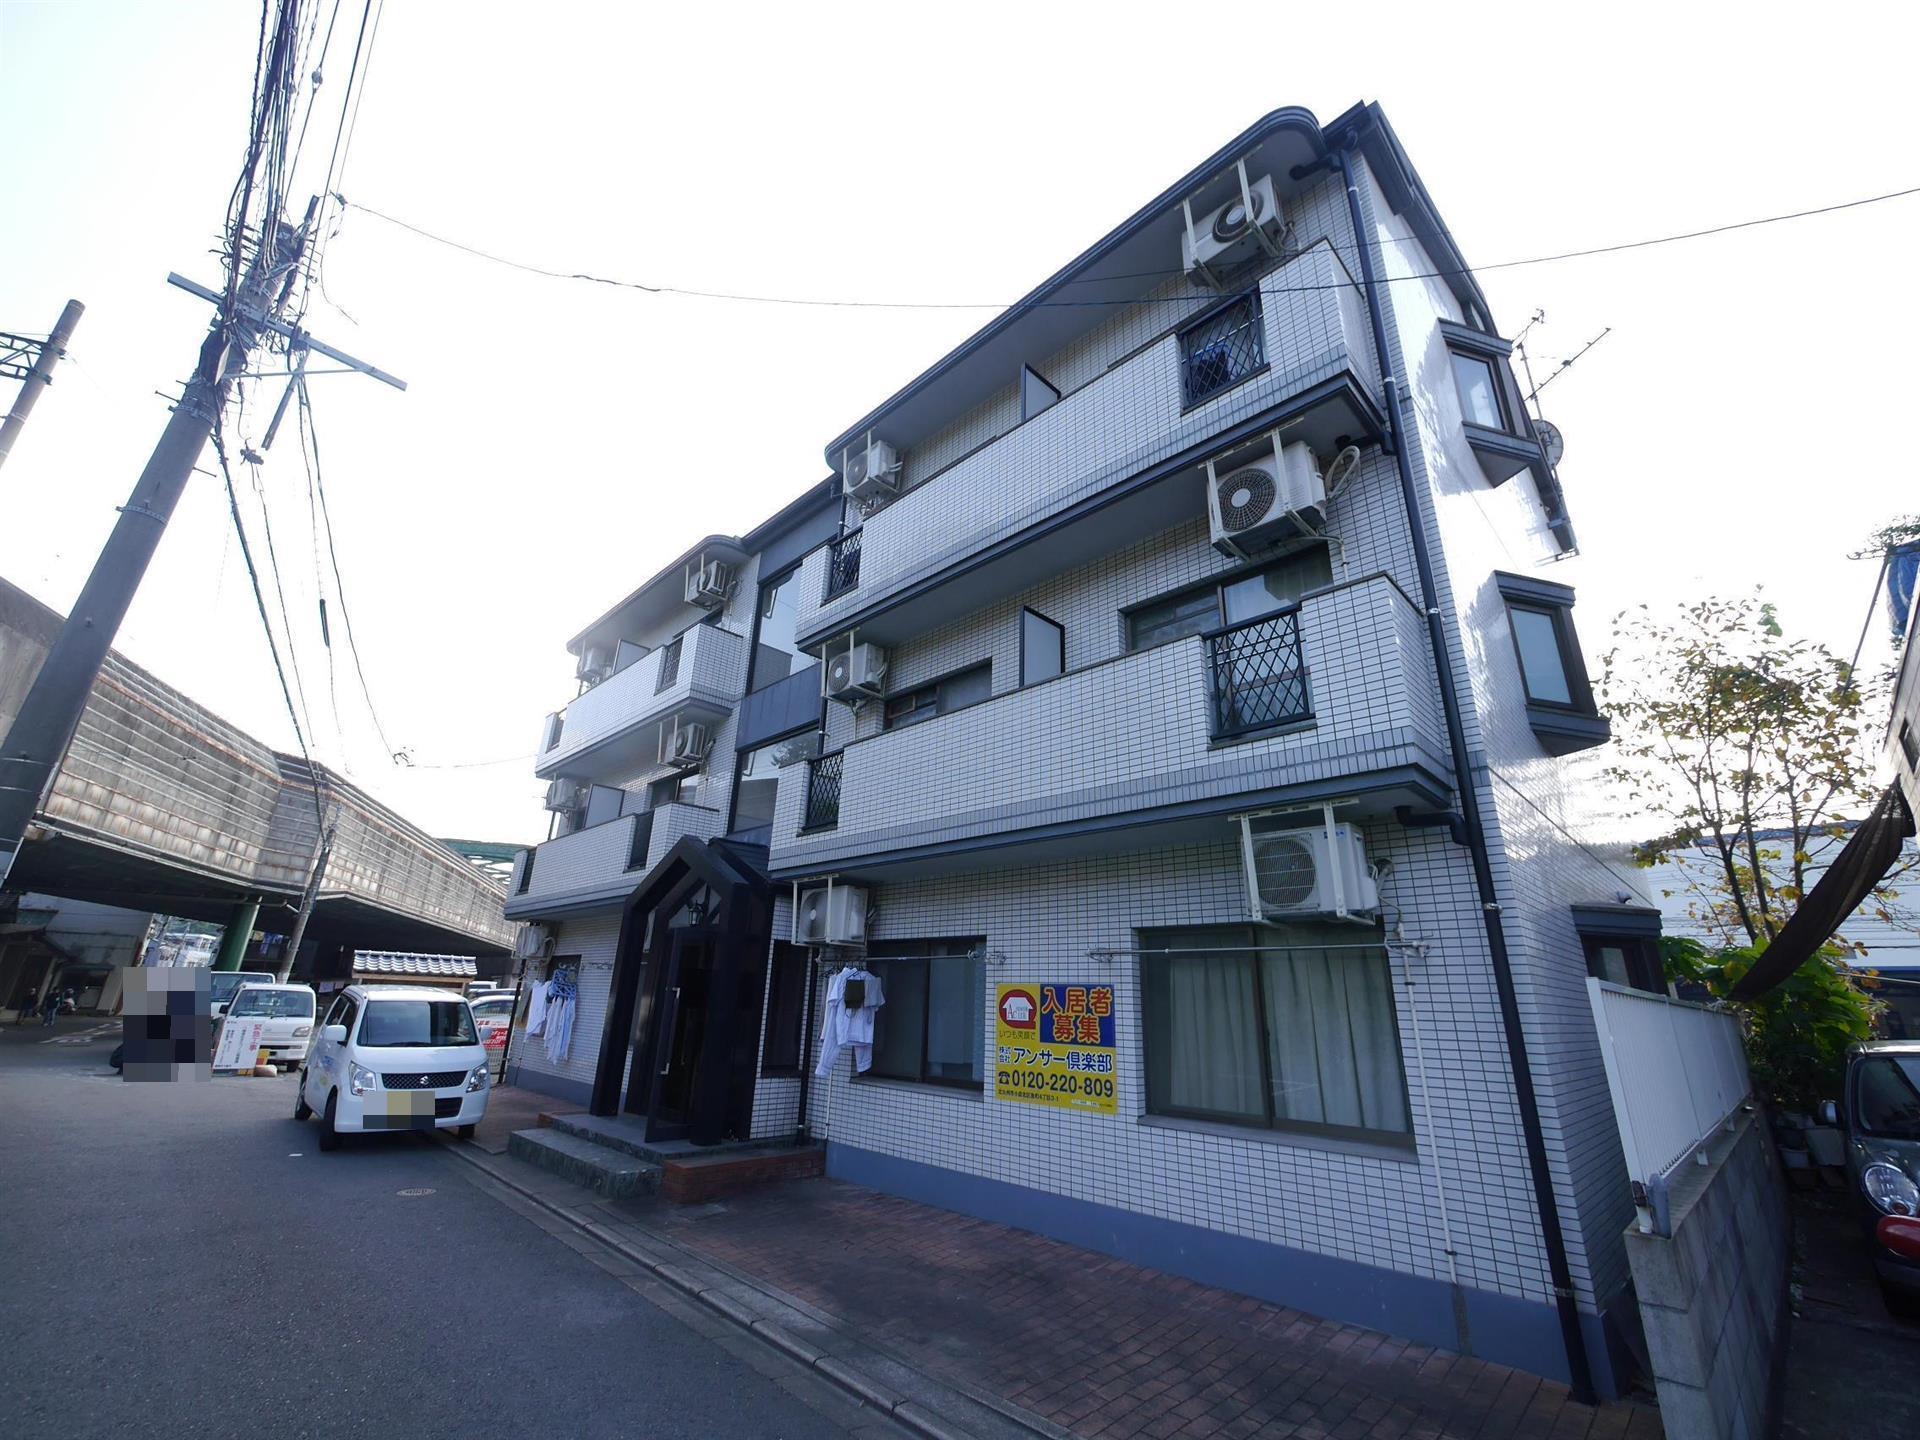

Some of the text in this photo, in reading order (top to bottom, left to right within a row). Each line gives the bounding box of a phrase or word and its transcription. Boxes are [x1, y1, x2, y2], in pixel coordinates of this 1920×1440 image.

[1042, 987, 1112, 1016] 入居者
[1053, 1014, 1100, 1042] 募集
[1013, 1047, 1113, 1073] アンサー倶楽部
[1012, 1070, 1113, 1098] 0120-220-809
